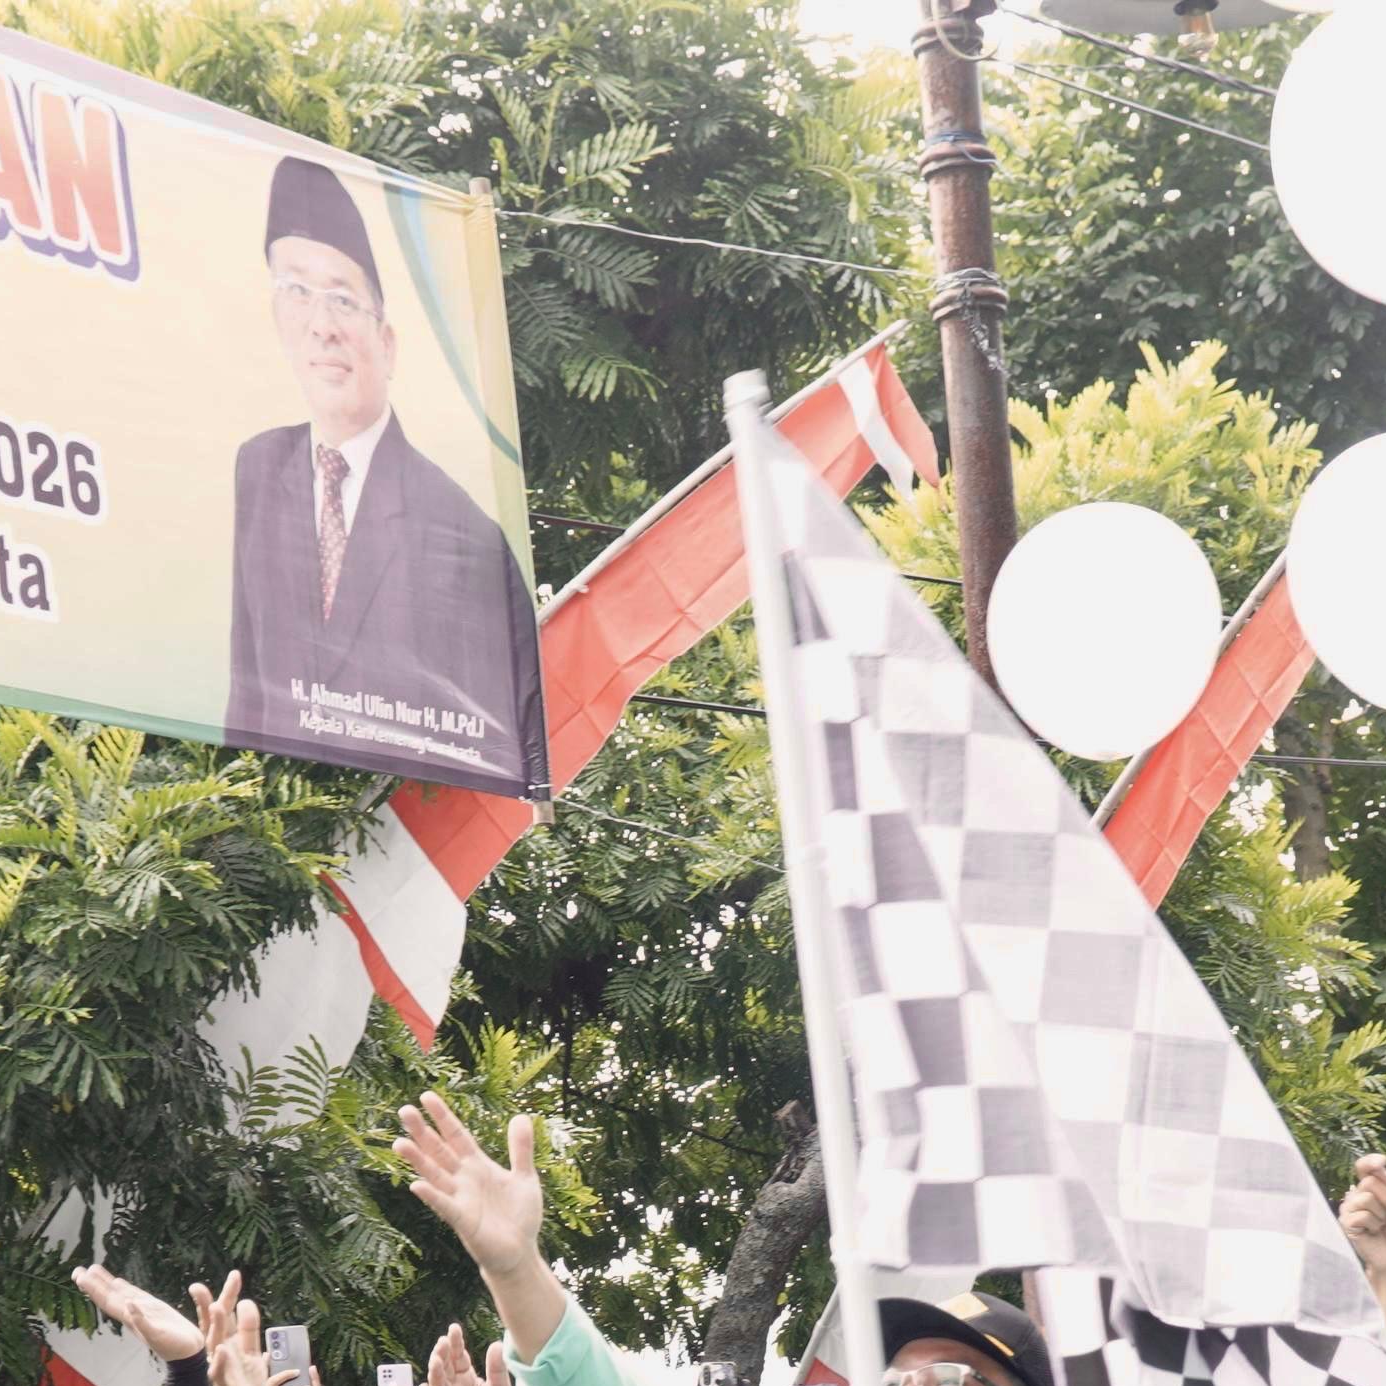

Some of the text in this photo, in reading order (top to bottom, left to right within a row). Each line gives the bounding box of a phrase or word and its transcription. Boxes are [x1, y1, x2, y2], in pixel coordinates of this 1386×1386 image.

[290, 677, 310, 703] H.
[310, 682, 364, 714] Ahmad
[395, 700, 423, 726] Nur
